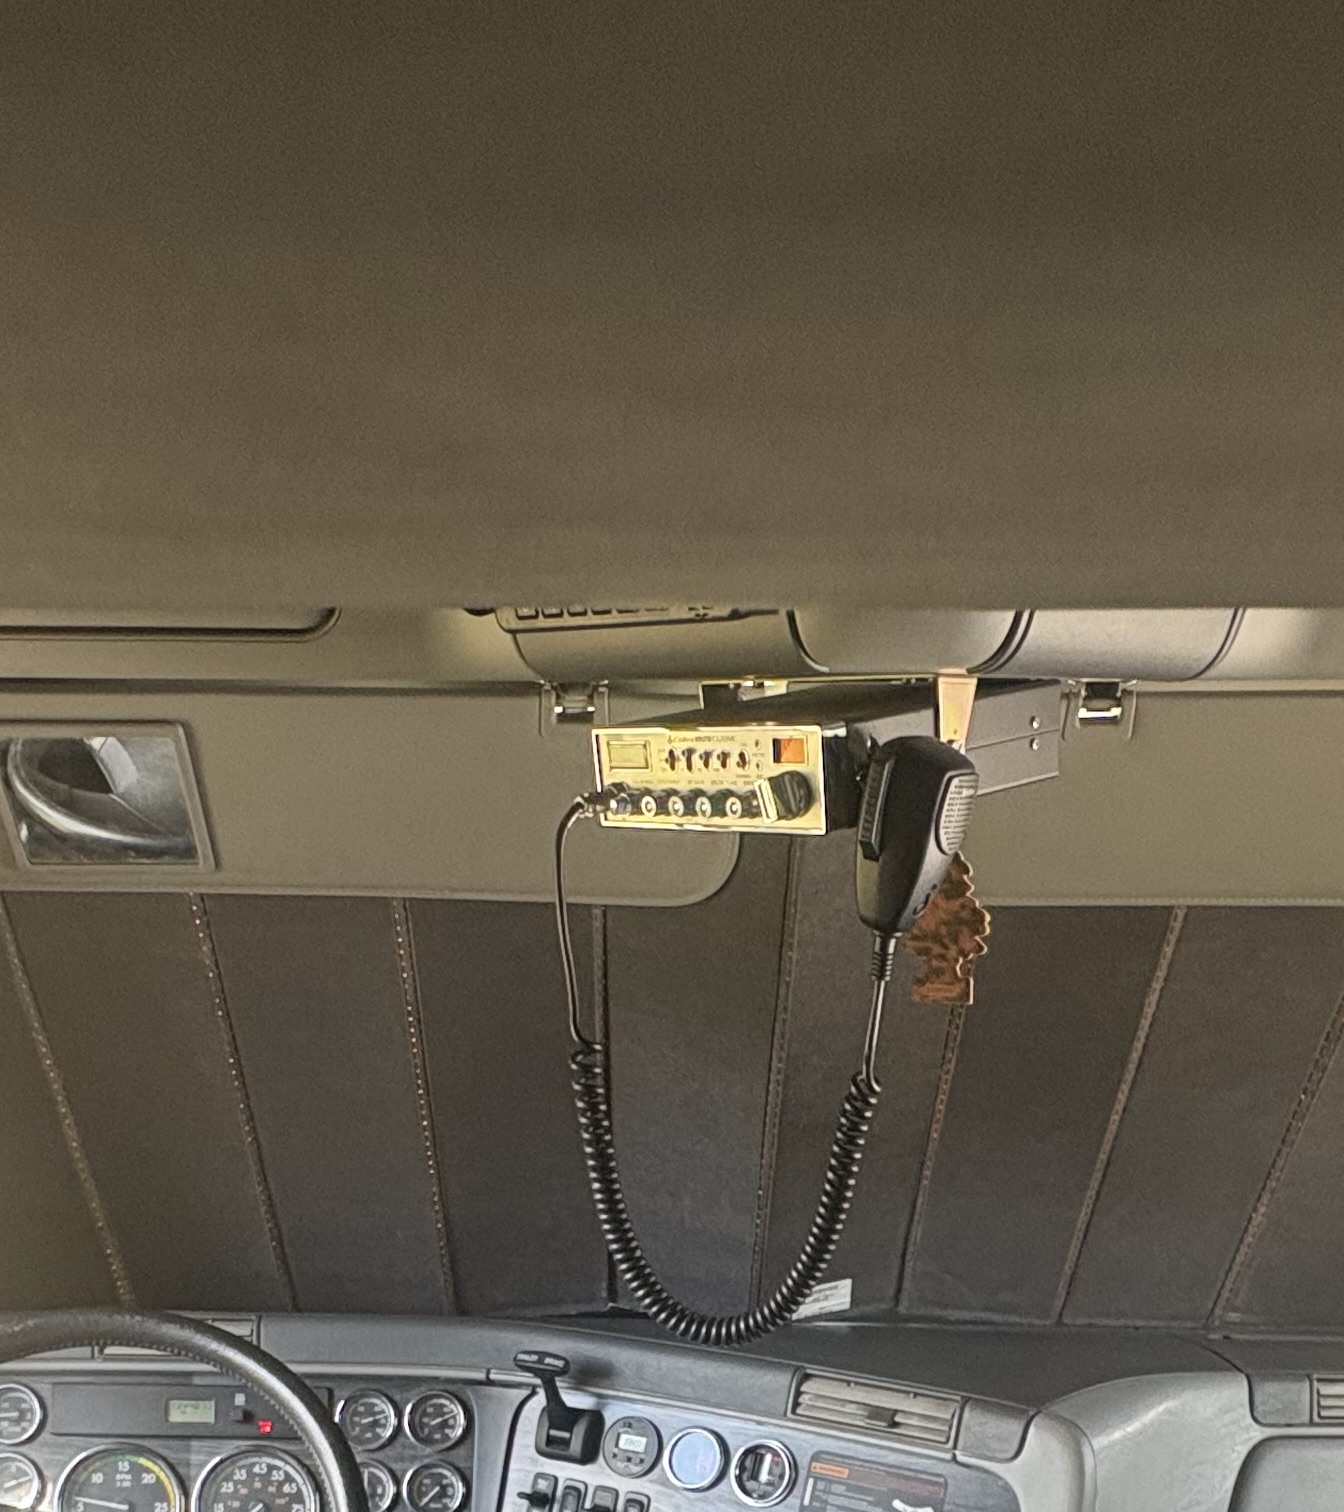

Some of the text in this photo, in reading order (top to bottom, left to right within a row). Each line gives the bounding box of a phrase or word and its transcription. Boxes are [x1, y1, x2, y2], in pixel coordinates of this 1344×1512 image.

[117, 1461, 130, 1472] 15
[252, 1462, 267, 1474] 45
[91, 1472, 104, 1483] 10
[141, 1472, 156, 1484] 20
[233, 1469, 247, 1480] 35
[271, 1470, 285, 1481] 55
[220, 1481, 234, 1493] 25
[283, 1483, 297, 1494] 65
[75, 1502, 84, 1512] 5
[154, 1502, 169, 1512] 25
